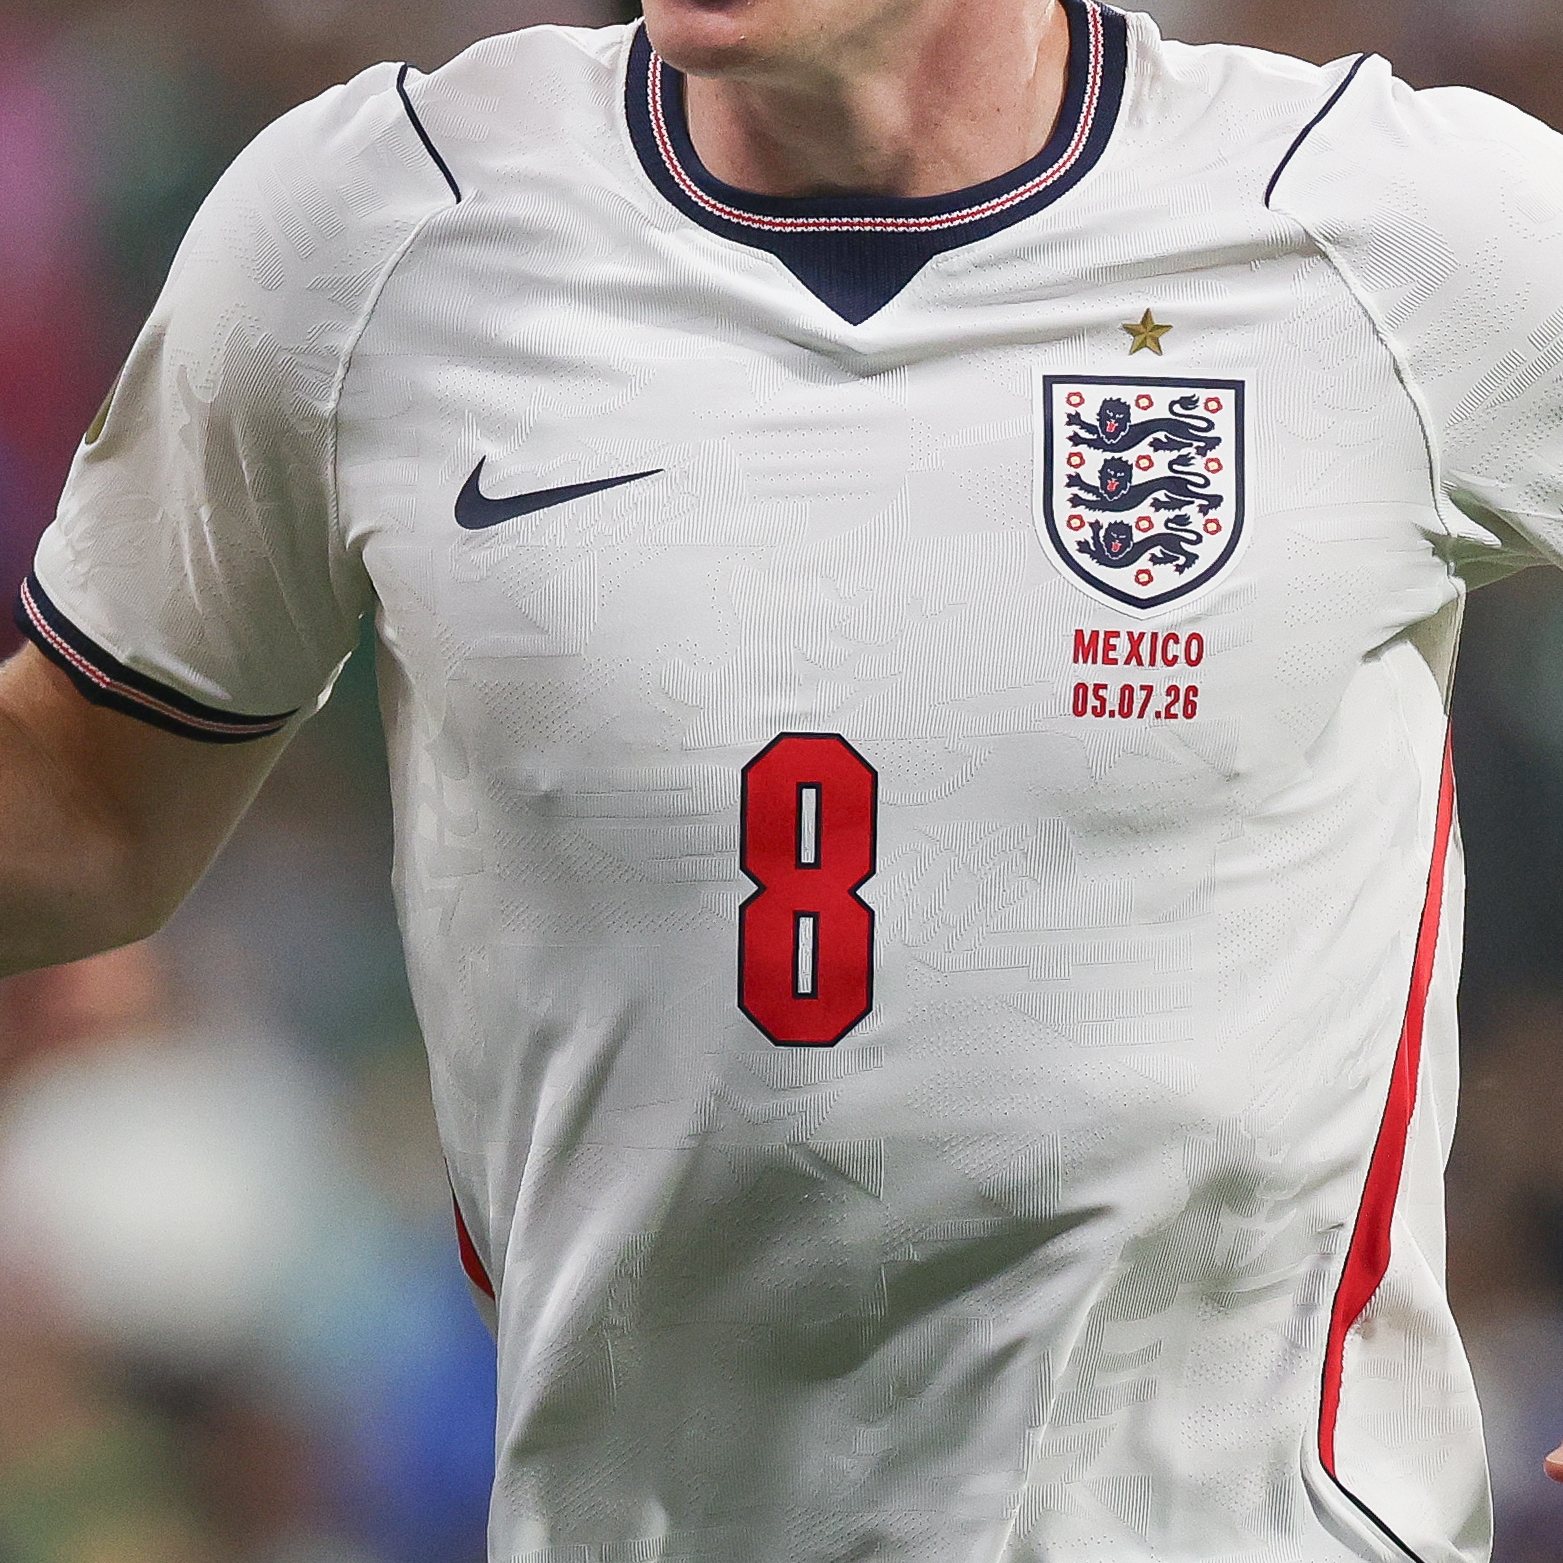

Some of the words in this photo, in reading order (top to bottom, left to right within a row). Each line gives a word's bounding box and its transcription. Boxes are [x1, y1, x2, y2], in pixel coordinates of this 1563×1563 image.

[1073, 629, 1204, 667] MEXICO
[1072, 682, 1199, 719] 05.07.26
[737, 732, 879, 1048] 8
